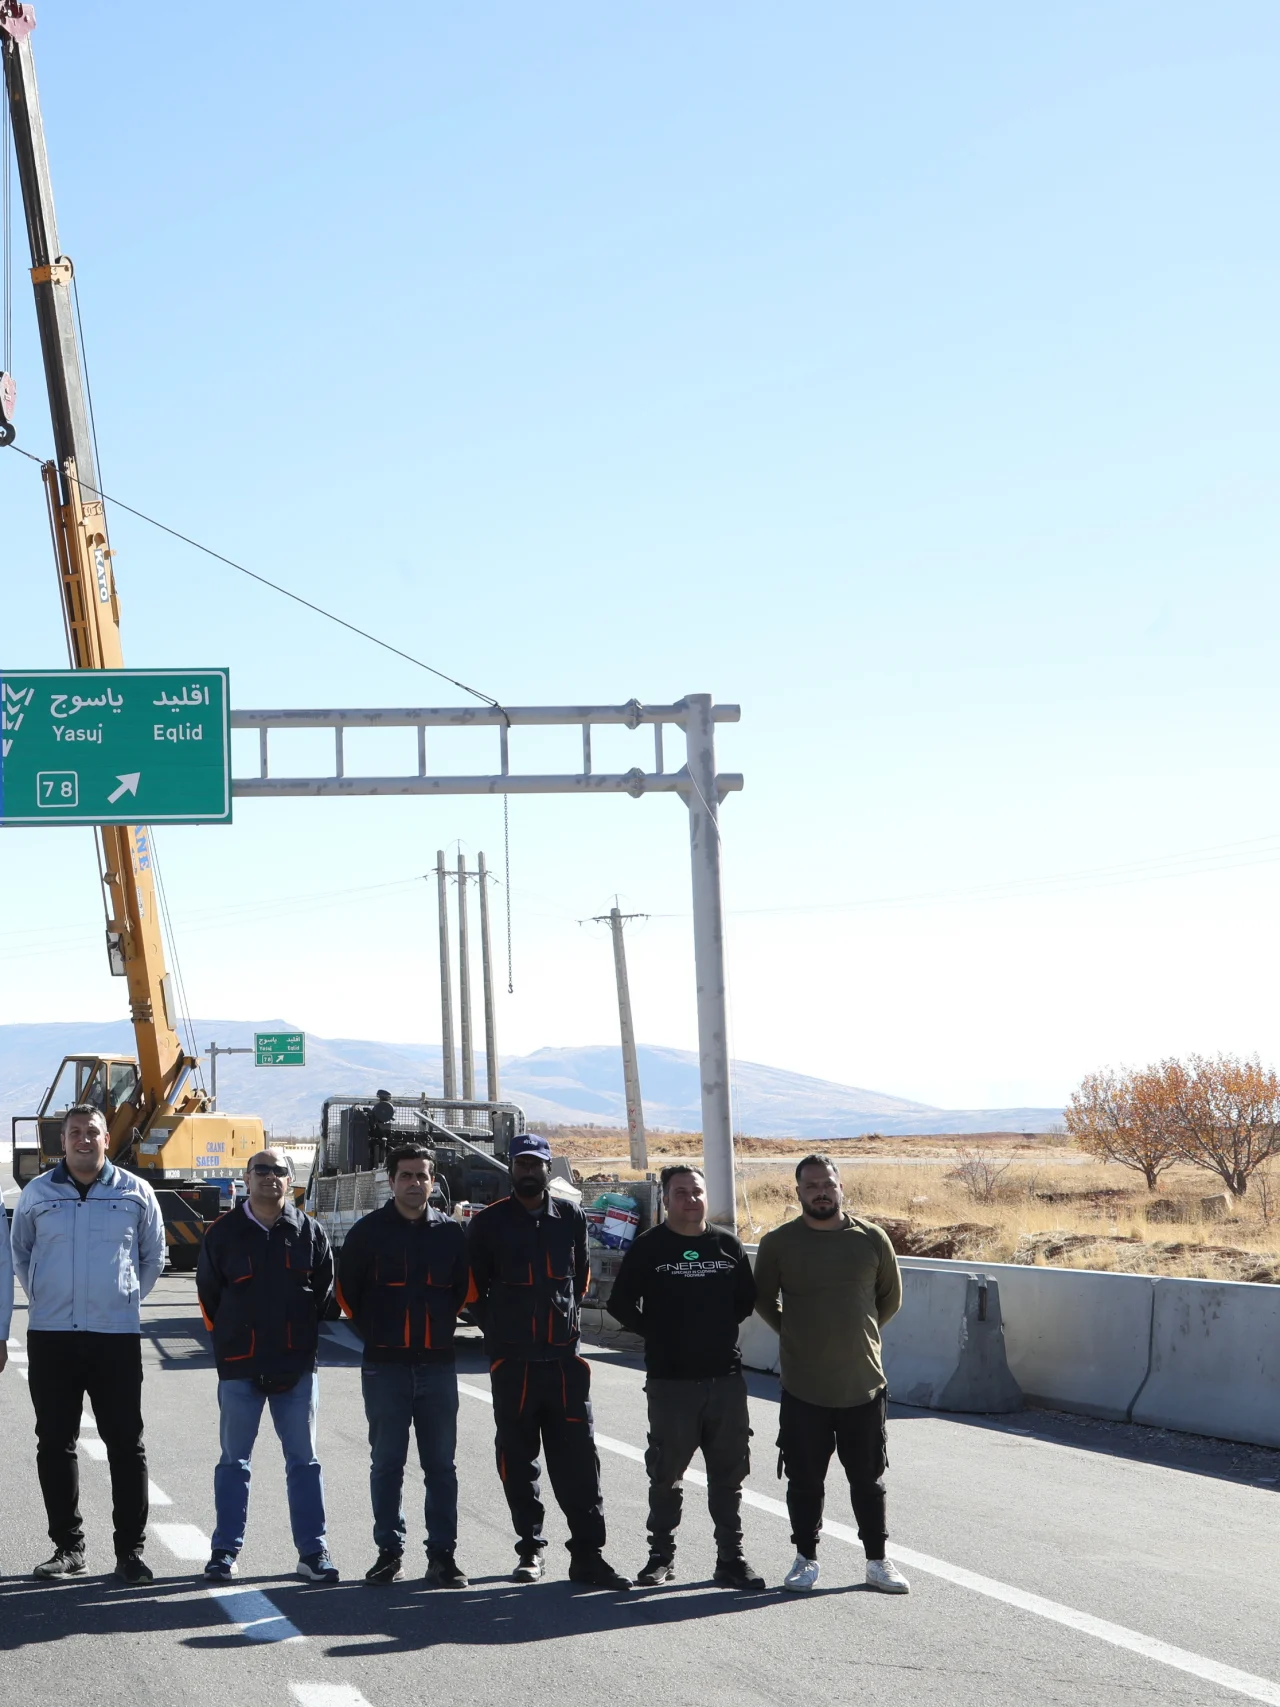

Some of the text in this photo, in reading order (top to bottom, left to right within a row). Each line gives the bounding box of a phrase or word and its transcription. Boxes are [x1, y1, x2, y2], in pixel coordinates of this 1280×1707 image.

[94, 550, 108, 601] KATO
[50, 687, 124, 719] یاسوج
[153, 684, 209, 713] اقلید
[52, 723, 103, 744] Yasuj
[153, 722, 203, 743] Eqlid
[206, 1142, 225, 1152] CRANE
[196, 1156, 220, 1167] SAEED
